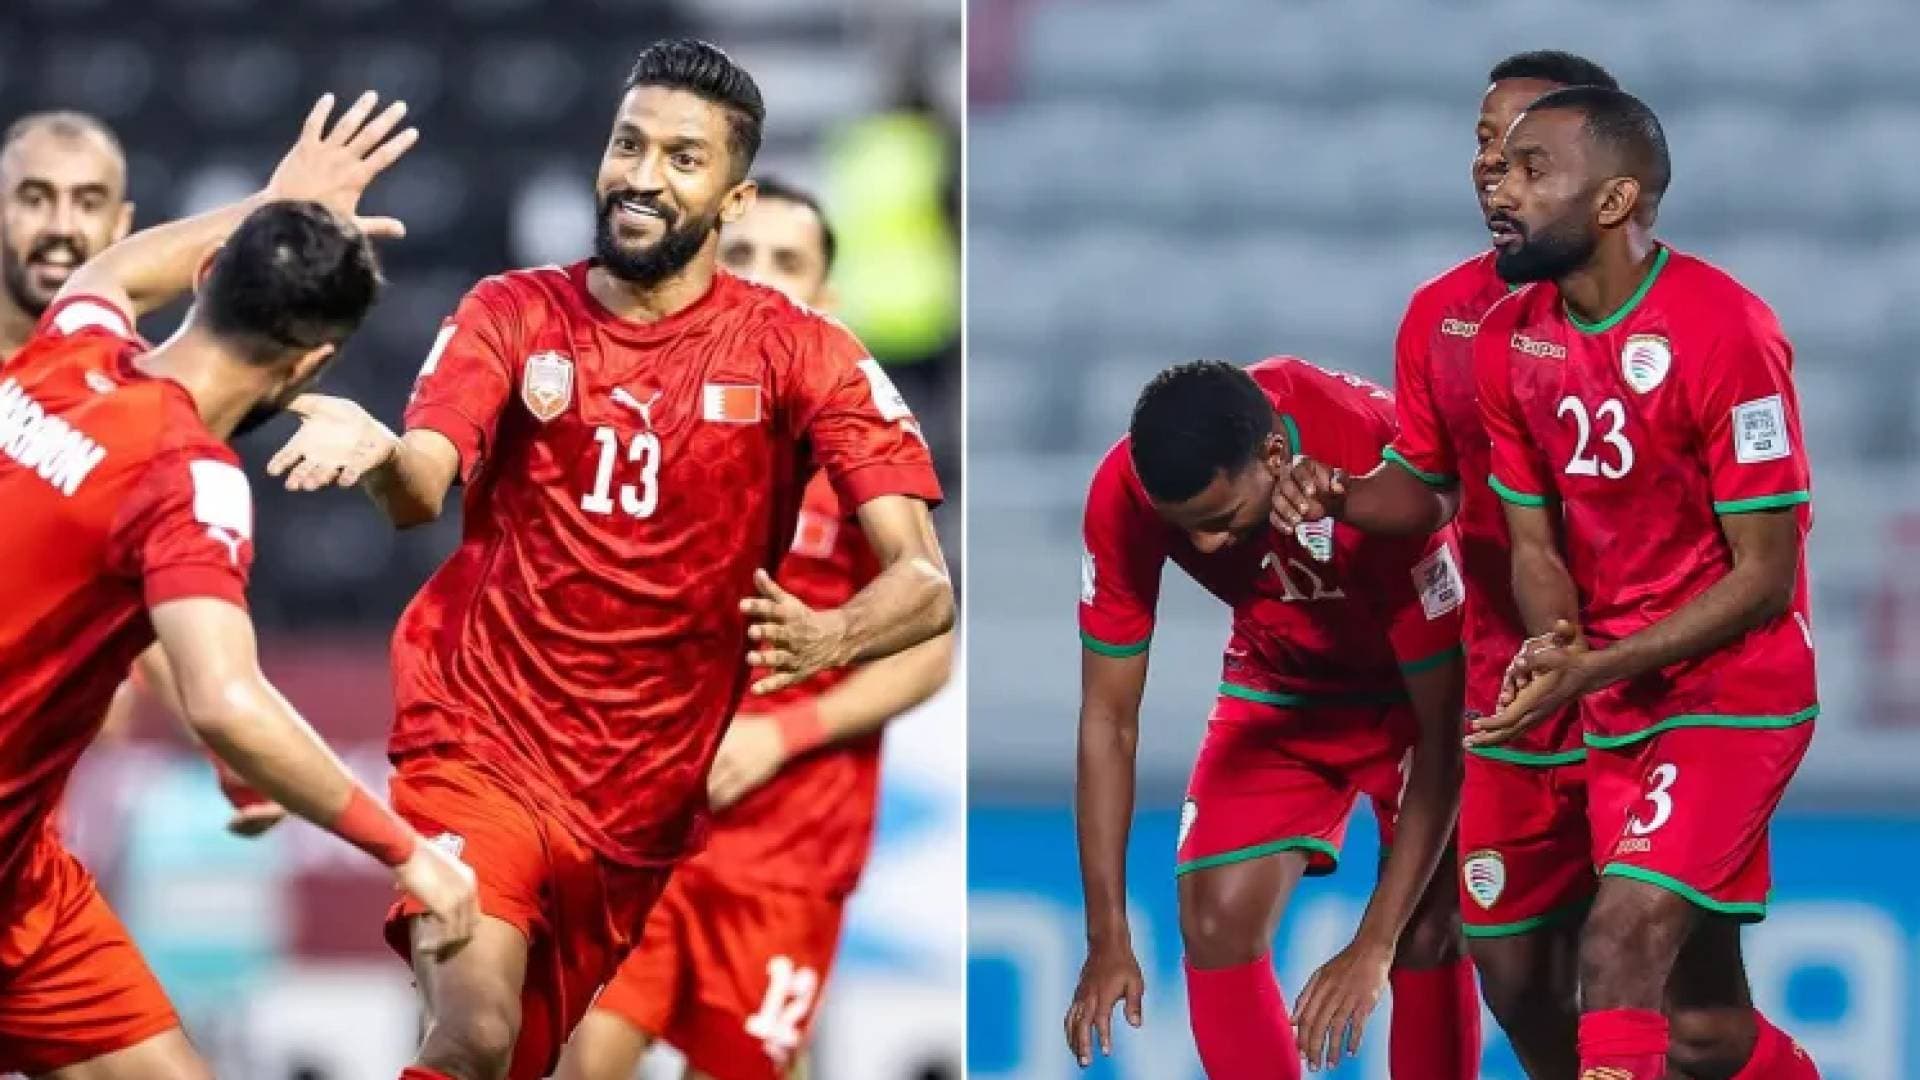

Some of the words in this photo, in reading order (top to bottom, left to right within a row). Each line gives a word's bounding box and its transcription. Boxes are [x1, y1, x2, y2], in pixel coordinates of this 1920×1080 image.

[580, 426, 662, 519] 13
[1557, 395, 1635, 480] 23
[1622, 762, 1678, 837] 3
